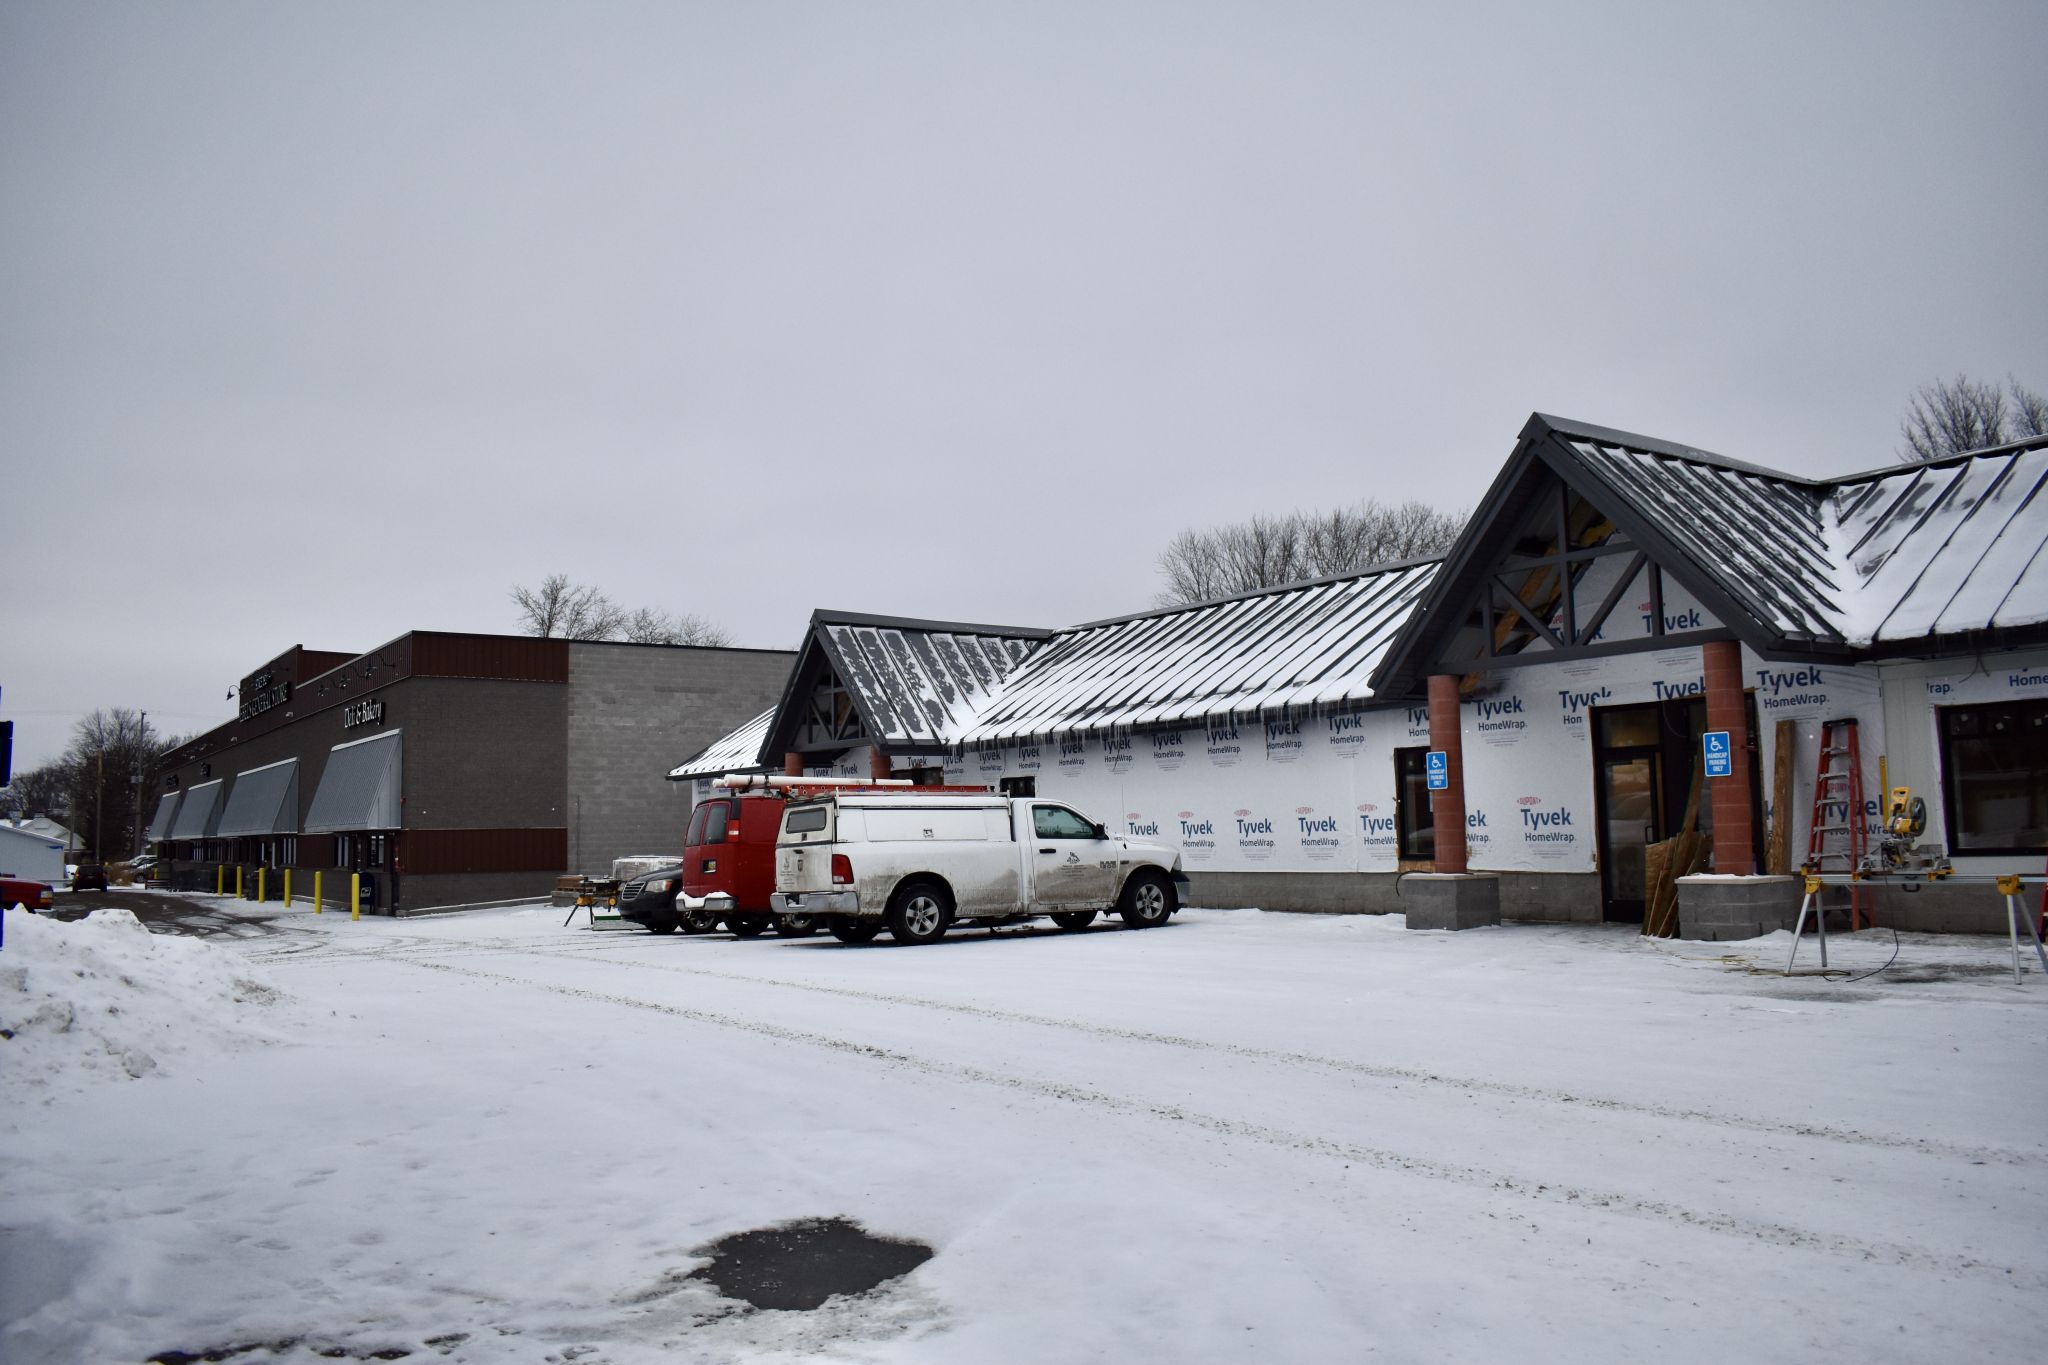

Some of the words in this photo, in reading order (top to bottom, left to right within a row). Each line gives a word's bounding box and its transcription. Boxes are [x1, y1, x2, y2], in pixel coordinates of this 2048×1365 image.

[1642, 608, 1701, 633] Tvek
[1756, 665, 1823, 695] Tyvek
[2008, 674, 2048, 687] Home
[1475, 695, 1524, 720] Tyvek
[1763, 694, 1828, 709] HomeWrap
[361, 699, 382, 726] Bakery
[1408, 707, 1430, 727] Tyv
[1264, 721, 1300, 740] Tyvek
[1326, 713, 1363, 735] Tyvk
[1478, 720, 1528, 732] HomeWrap
[1151, 731, 1183, 750] Tyvek
[1205, 727, 1239, 745] Tyvek
[1330, 735, 1365, 744] Homerap
[1207, 745, 1241, 755] HomeWrap
[1266, 740, 1302, 750] HomeWrap
[1104, 754, 1133, 763] HomeWrap
[1153, 750, 1185, 759] HomeWrap
[841, 764, 858, 778] Tyvek
[1298, 816, 1337, 837] Tyvek
[1520, 807, 1573, 831] Tyvek
[1129, 821, 1159, 836] Tyvek
[1181, 820, 1213, 838] Tyvek
[1237, 818, 1272, 837] Tyvek
[1182, 840, 1215, 848] HomeWrap
[1239, 839, 1274, 848] HomeWrap
[1301, 838, 1339, 847] HomeWrap
[1364, 836, 1397, 845] HomeWr
[1467, 833, 1489, 842] Wrap
[1525, 832, 1575, 843] HomeWrap
